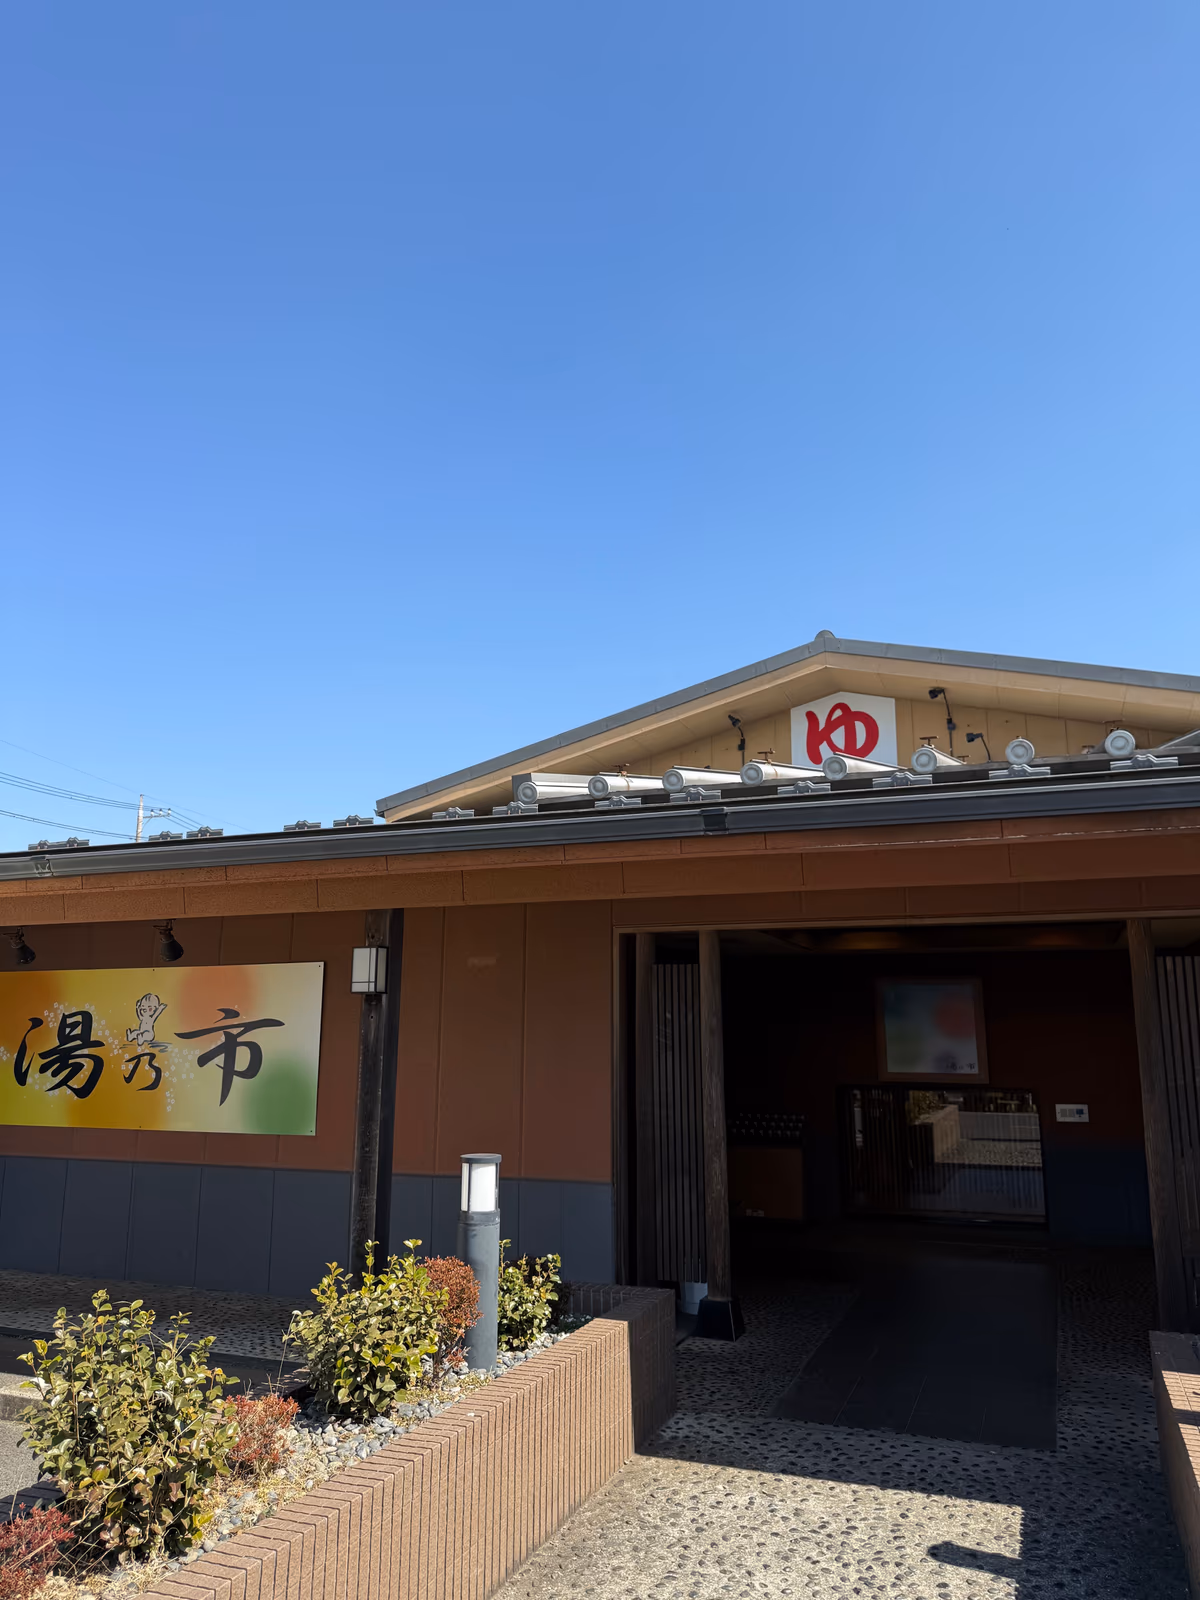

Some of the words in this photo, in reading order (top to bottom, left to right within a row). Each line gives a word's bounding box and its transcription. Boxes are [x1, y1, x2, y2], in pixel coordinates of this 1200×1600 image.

[805, 702, 879, 765] ゆ
[13, 1008, 286, 1107] 湯乃市
